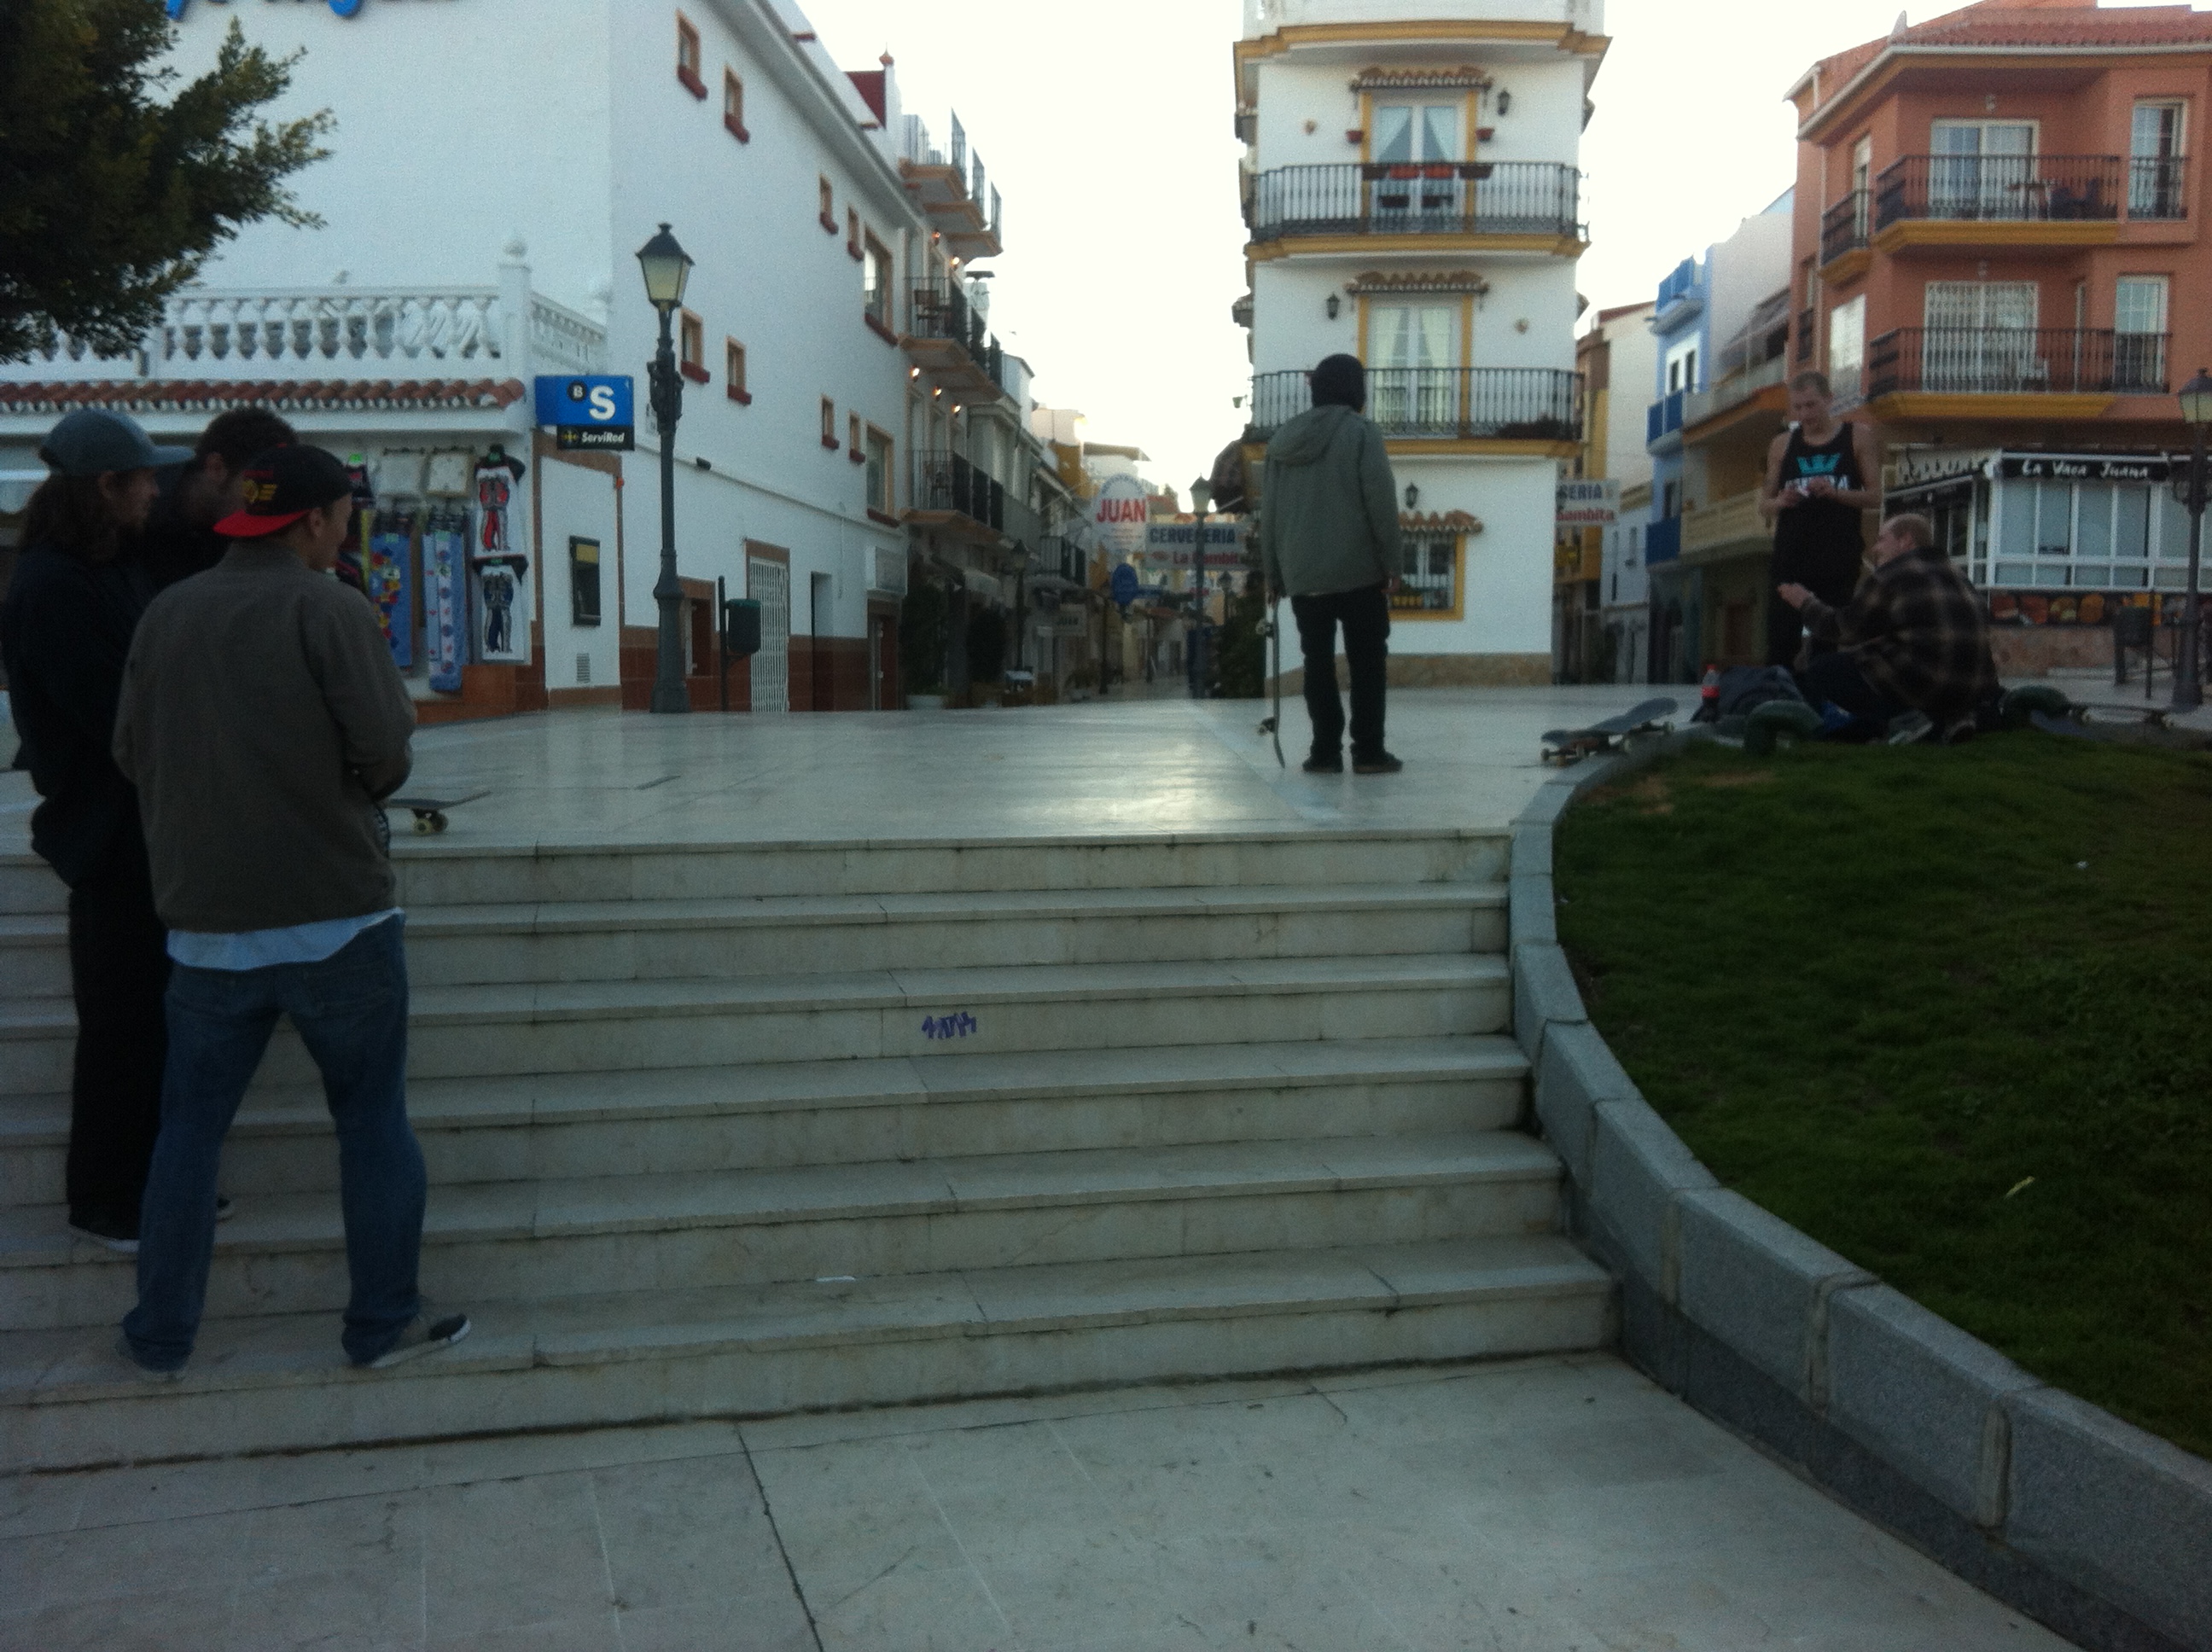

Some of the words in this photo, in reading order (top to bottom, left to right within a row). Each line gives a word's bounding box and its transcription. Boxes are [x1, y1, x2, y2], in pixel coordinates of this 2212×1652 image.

[588, 384, 616, 422] S
[581, 431, 626, 443] ServiRed
[1097, 498, 1146, 523] JUAN
[1150, 527, 1236, 544] CERVEERIA
